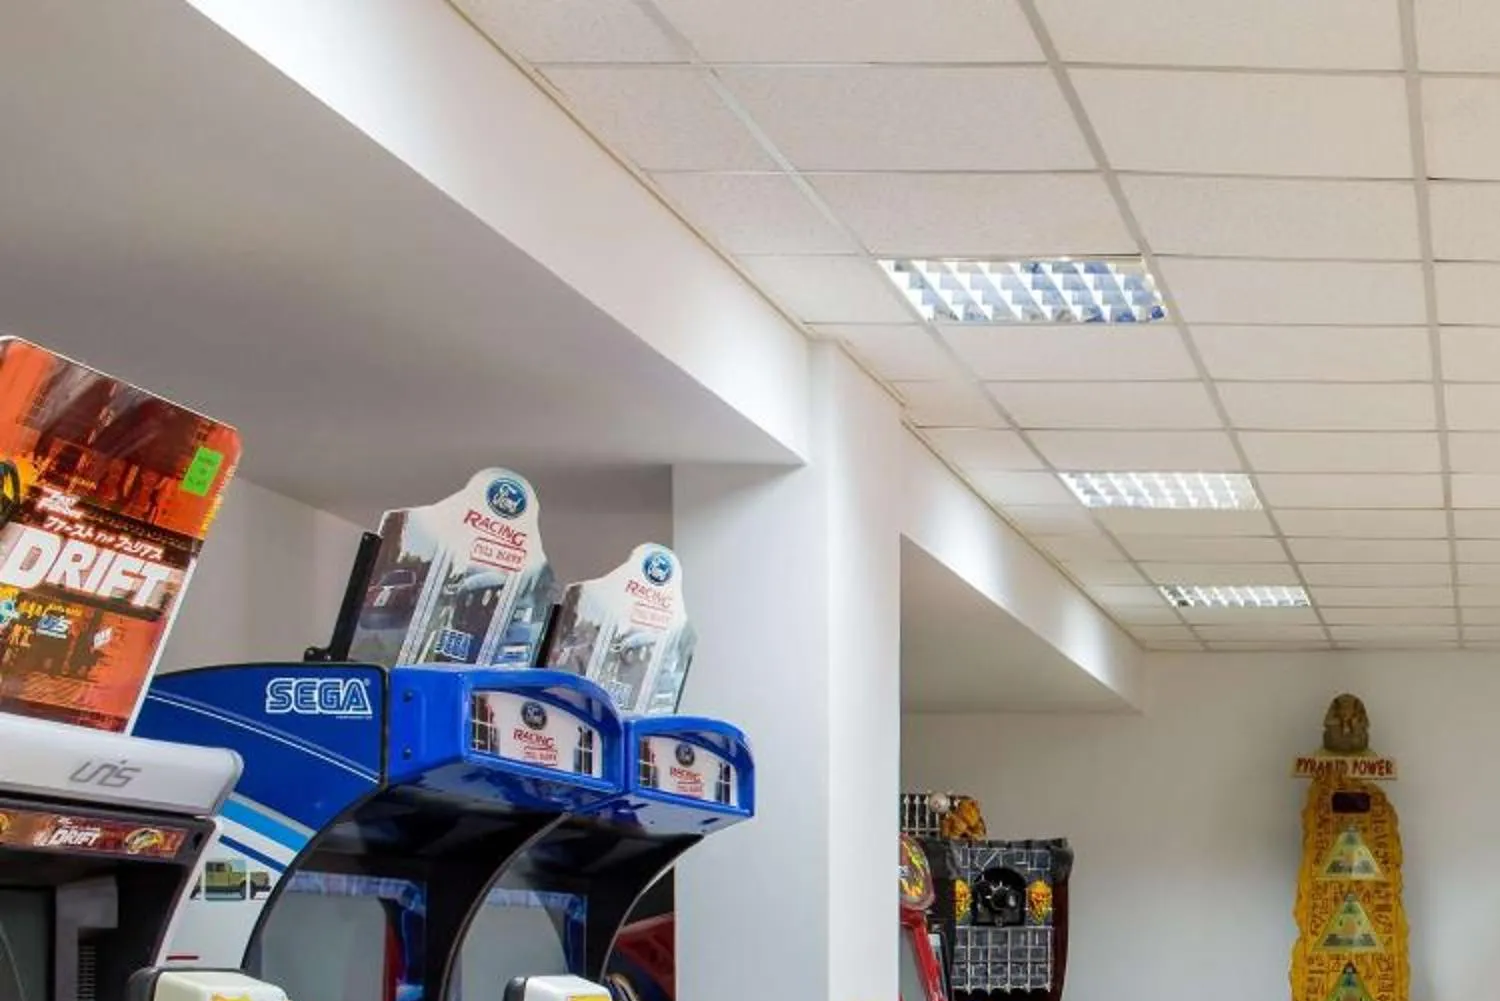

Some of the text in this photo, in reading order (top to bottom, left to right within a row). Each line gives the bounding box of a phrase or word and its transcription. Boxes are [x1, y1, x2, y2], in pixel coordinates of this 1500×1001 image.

[464, 509, 527, 547] RACING
[1, 526, 171, 608] DRIFT
[624, 579, 672, 608] RACING
[265, 677, 373, 715] SEGA
[1352, 758, 1393, 776] POWER
